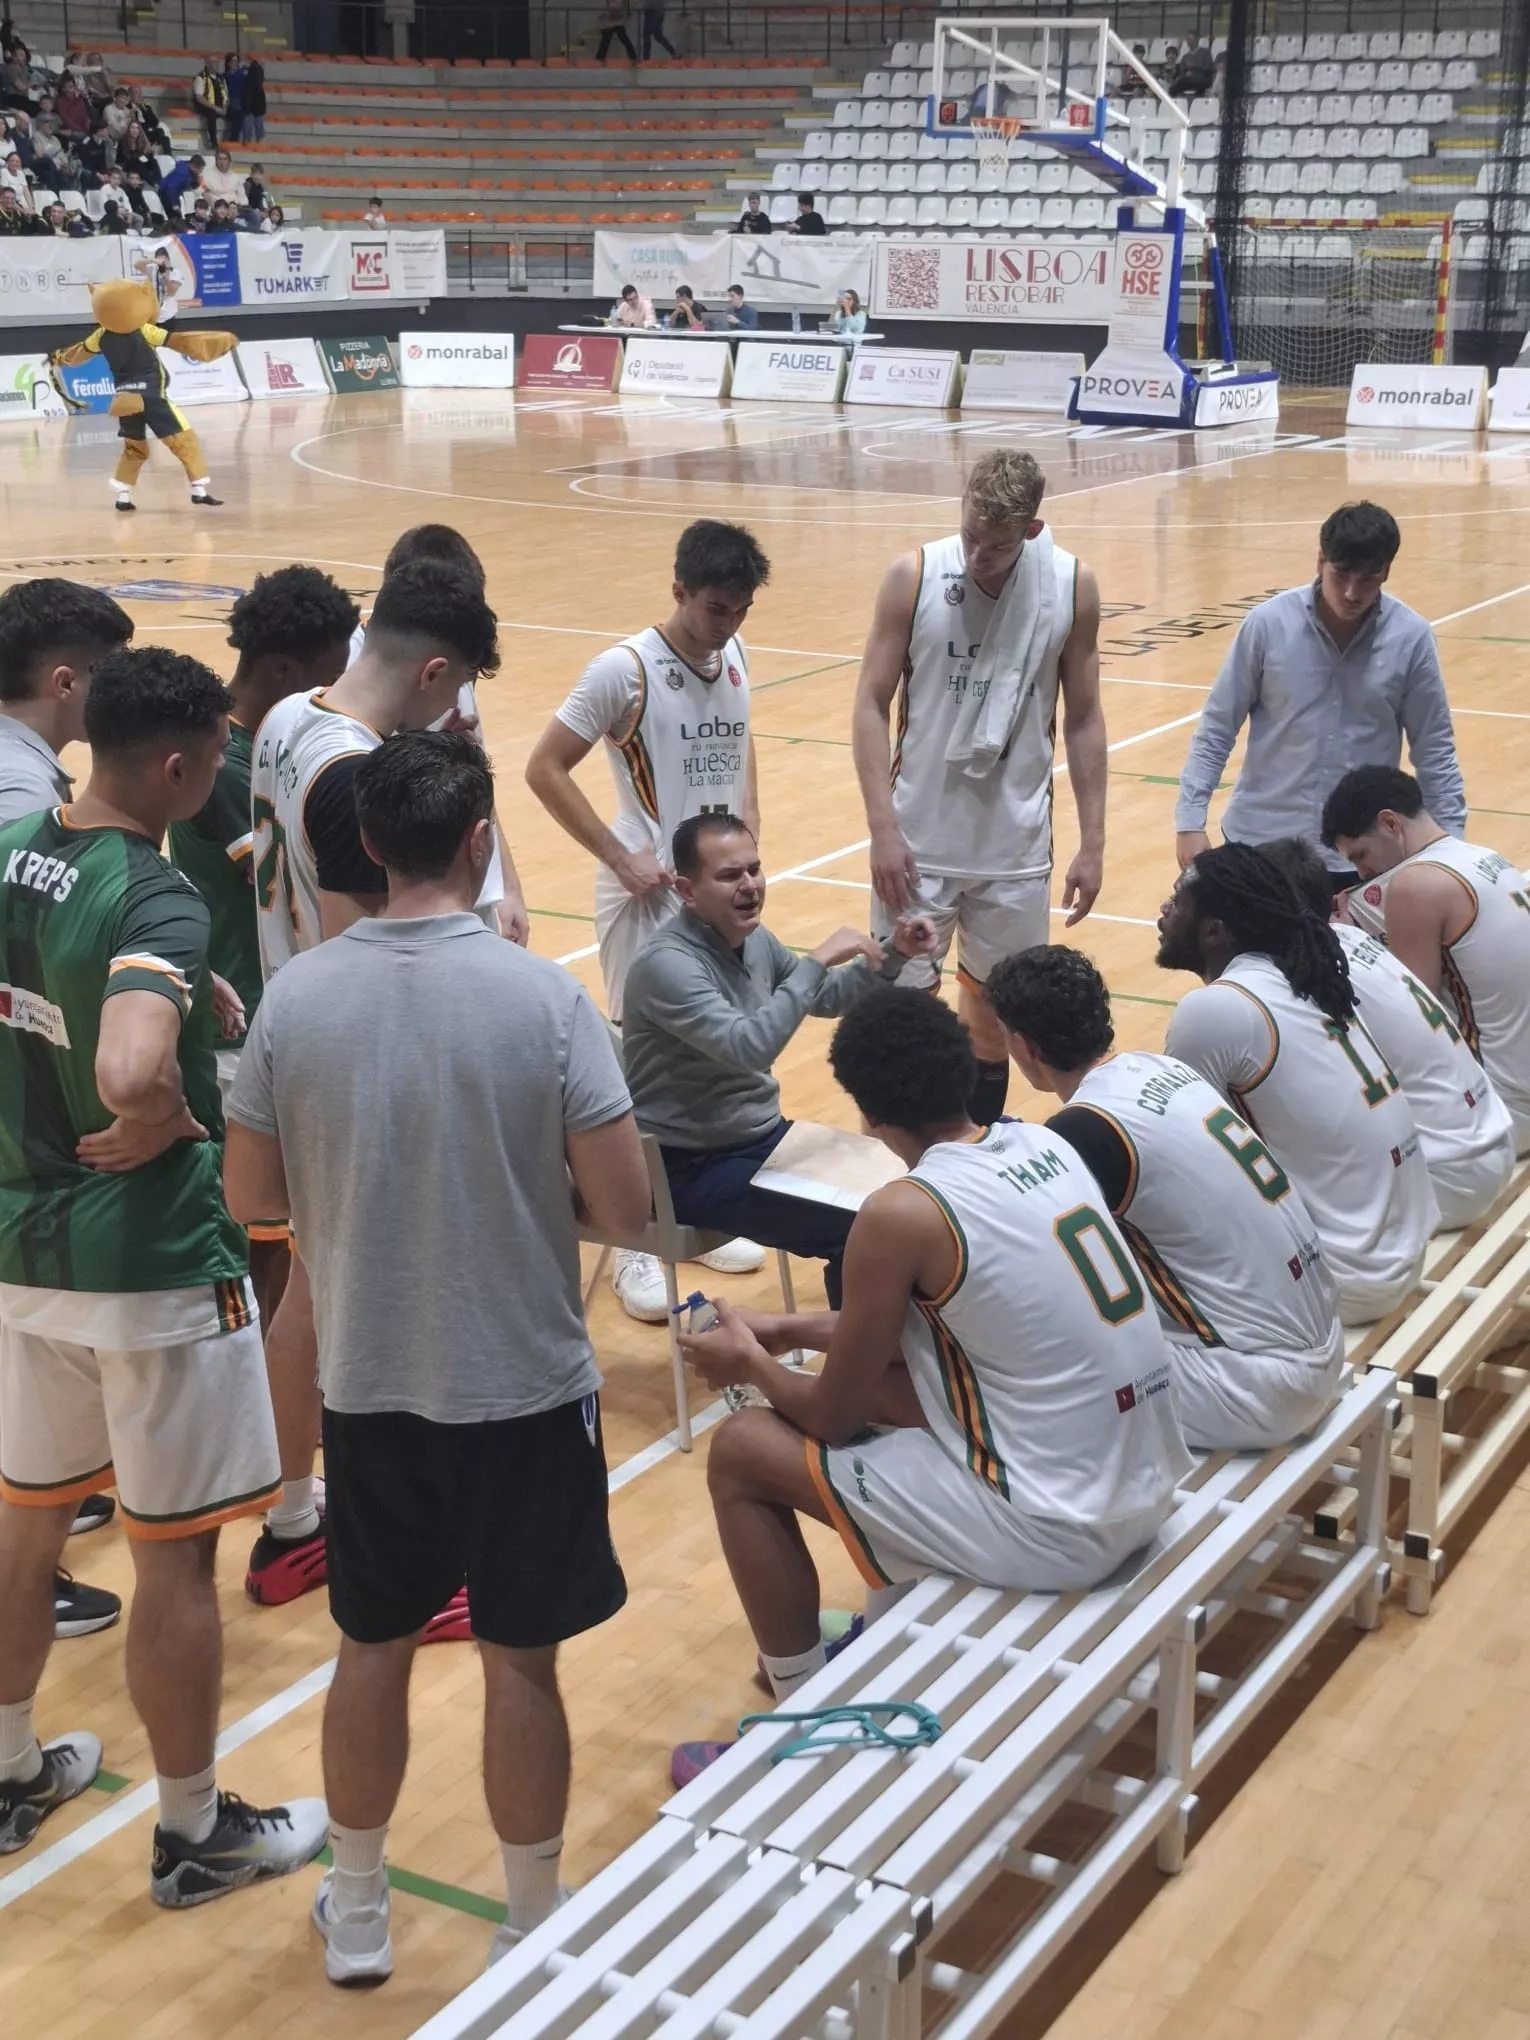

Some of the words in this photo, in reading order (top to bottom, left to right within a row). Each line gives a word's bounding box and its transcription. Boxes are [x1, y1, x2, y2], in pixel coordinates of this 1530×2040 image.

[966, 248, 1107, 285] LISBOA
[966, 284, 1065, 304] RESTOBAR
[1121, 270, 1162, 295] HSE
[965, 304, 1020, 315] VALENCIA
[426, 344, 508, 360] monrabal
[768, 353, 836, 371] FAUBEL
[909, 366, 942, 381] SUSI
[1083, 377, 1177, 399] PROVEA
[1219, 387, 1263, 412] PROVEA
[1377, 387, 1474, 406] monrabal
[681, 715, 745, 740] Lobe
[3, 848, 79, 903] KREPS
[1202, 1105, 1293, 1207] 6
[997, 1148, 1070, 1195] THAM
[1053, 1202, 1146, 1328] 0
